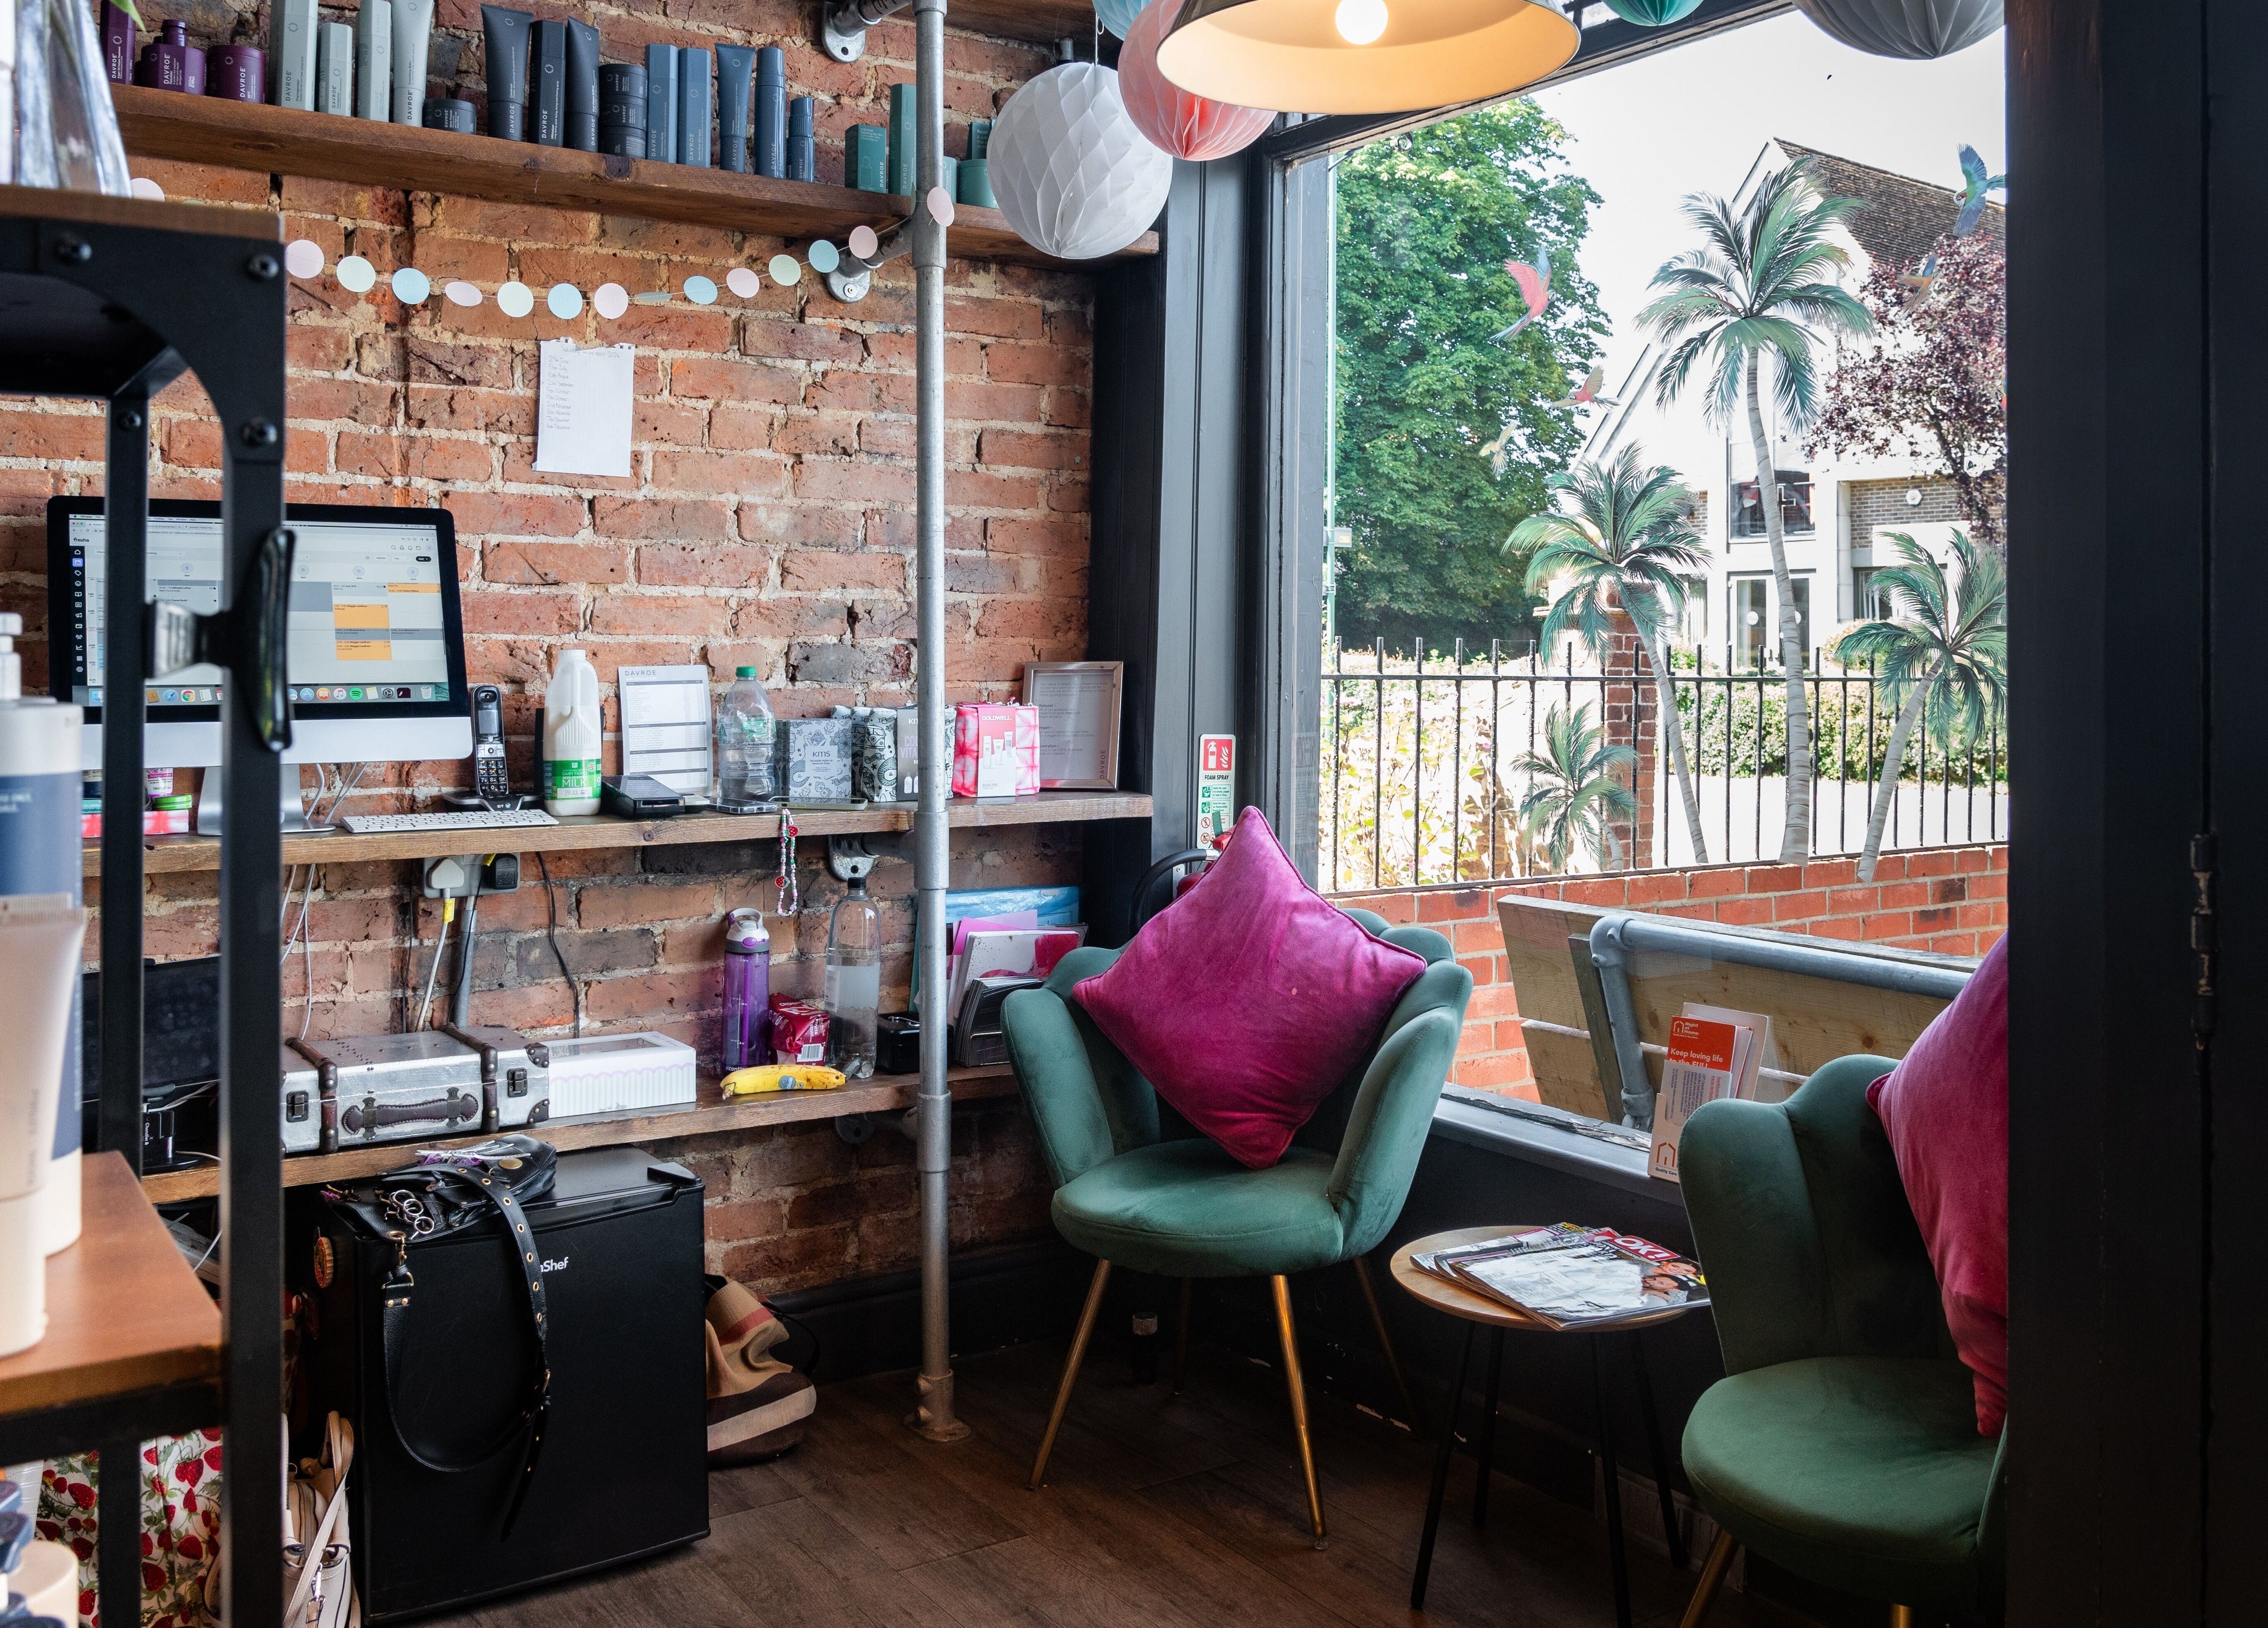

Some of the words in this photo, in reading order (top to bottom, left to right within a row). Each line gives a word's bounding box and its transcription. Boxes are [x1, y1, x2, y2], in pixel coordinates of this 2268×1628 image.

[900, 747, 918, 758] VITA
[562, 778, 587, 787] MILK
[1671, 1048, 1688, 1058] Keep
[1690, 1050, 1710, 1062] loving
[1712, 1054, 1723, 1062] life
[1614, 1238, 1671, 1259] OK!
